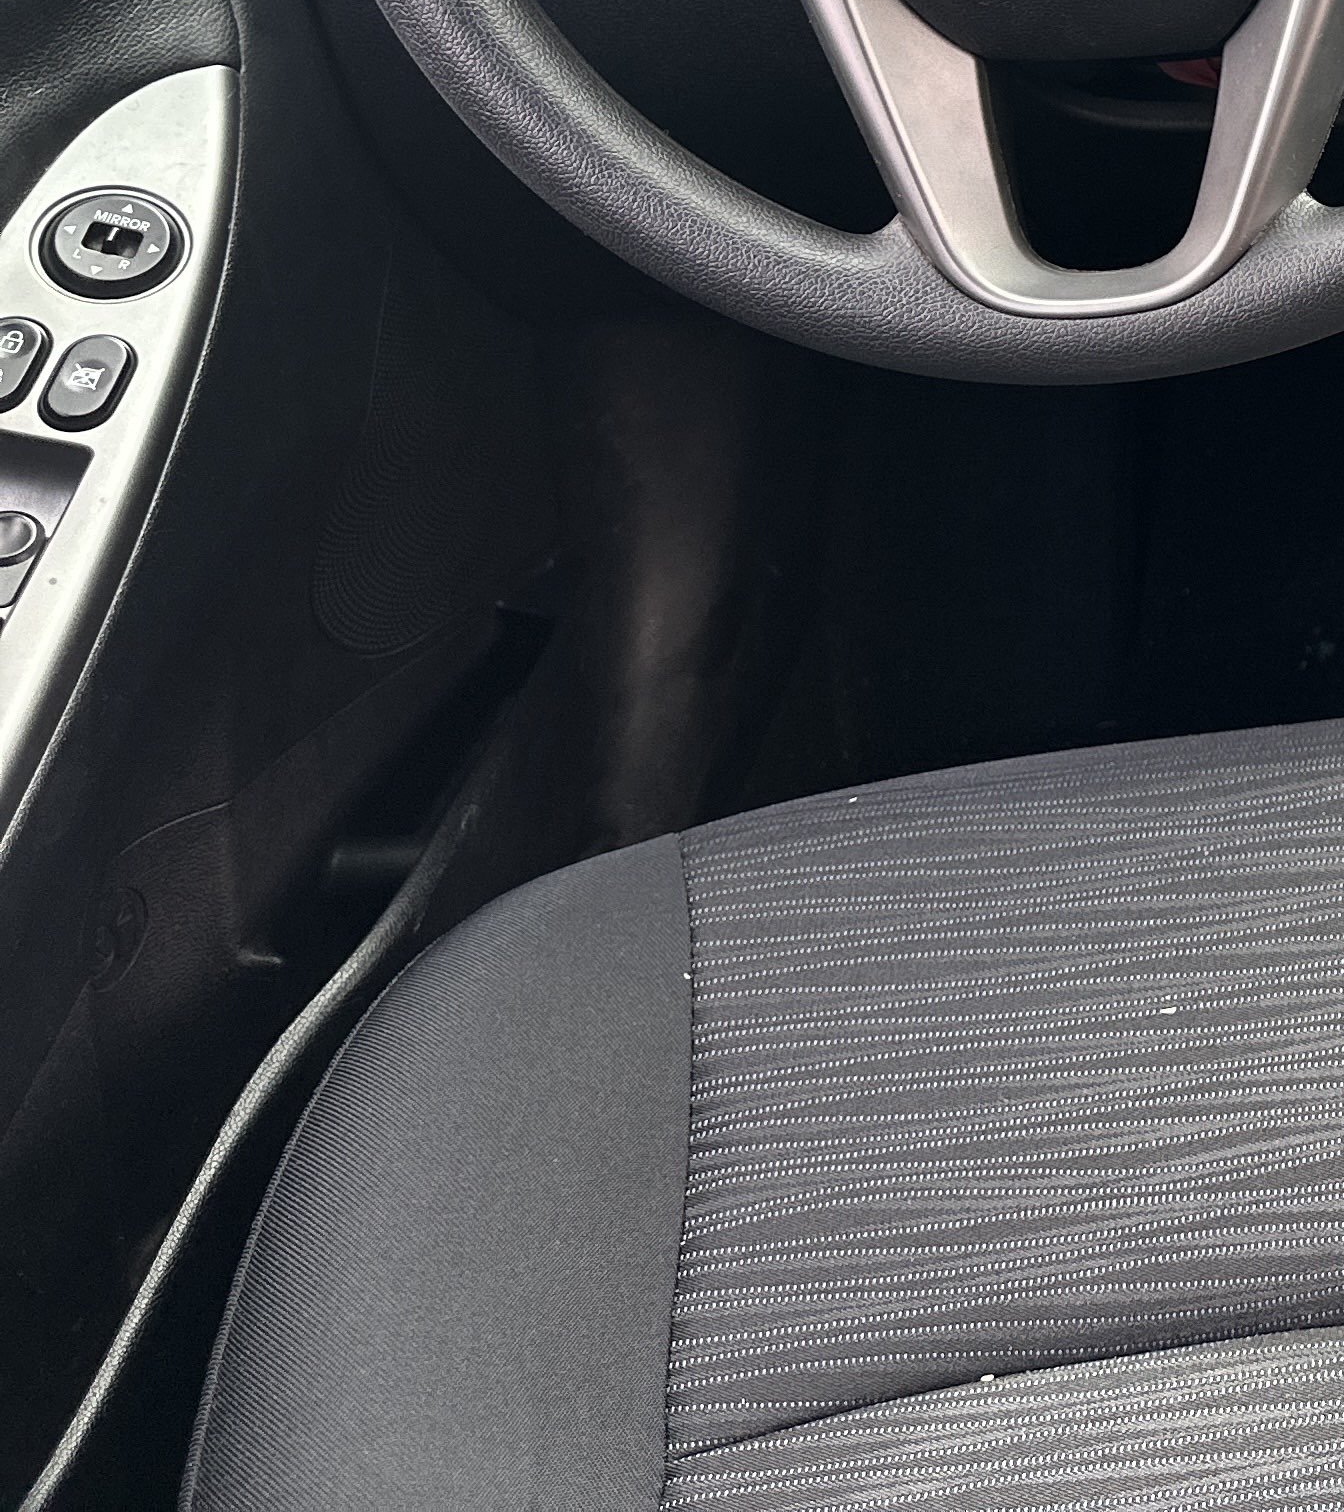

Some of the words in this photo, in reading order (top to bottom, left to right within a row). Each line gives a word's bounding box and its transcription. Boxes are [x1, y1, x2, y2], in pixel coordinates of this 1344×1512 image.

[93, 209, 151, 232] MIRROR
[72, 248, 82, 259] L
[118, 259, 131, 270] R
